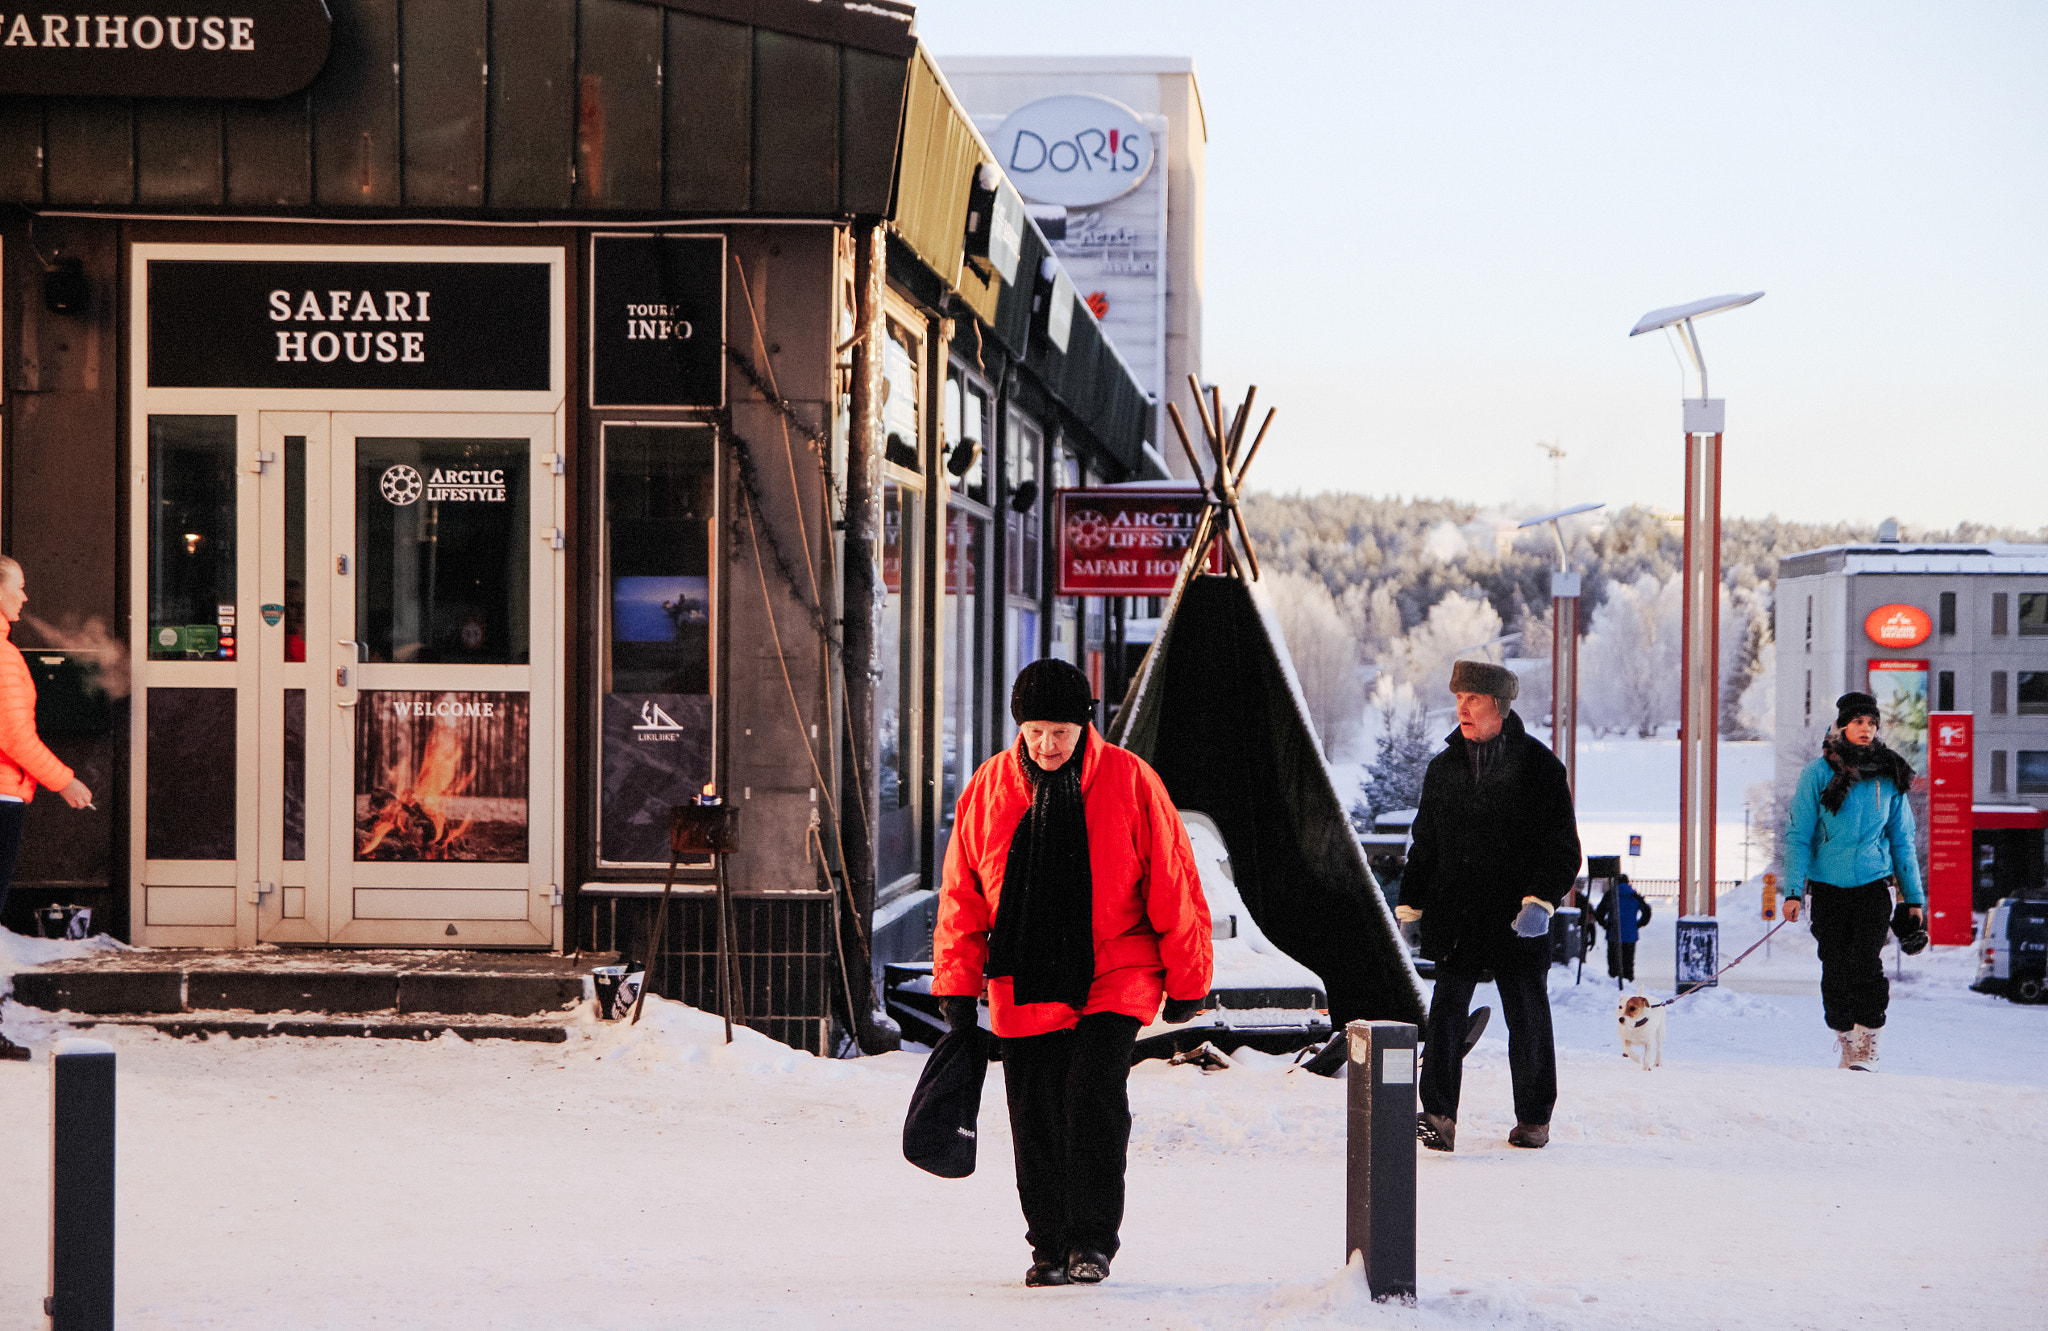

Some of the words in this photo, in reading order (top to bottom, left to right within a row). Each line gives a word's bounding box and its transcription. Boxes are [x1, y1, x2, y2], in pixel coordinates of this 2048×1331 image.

[0, 14, 255, 50] ARIHOUSE
[269, 289, 431, 322] SAFARI
[628, 320, 693, 339] INFO
[275, 331, 425, 362] HOUSE
[429, 468, 504, 484] ARCTIC
[427, 488, 506, 501] LIFESTYLE
[1109, 533, 1190, 548] LIFESTY
[1072, 559, 1138, 576] SAFARI
[393, 701, 494, 717] WELCOME
